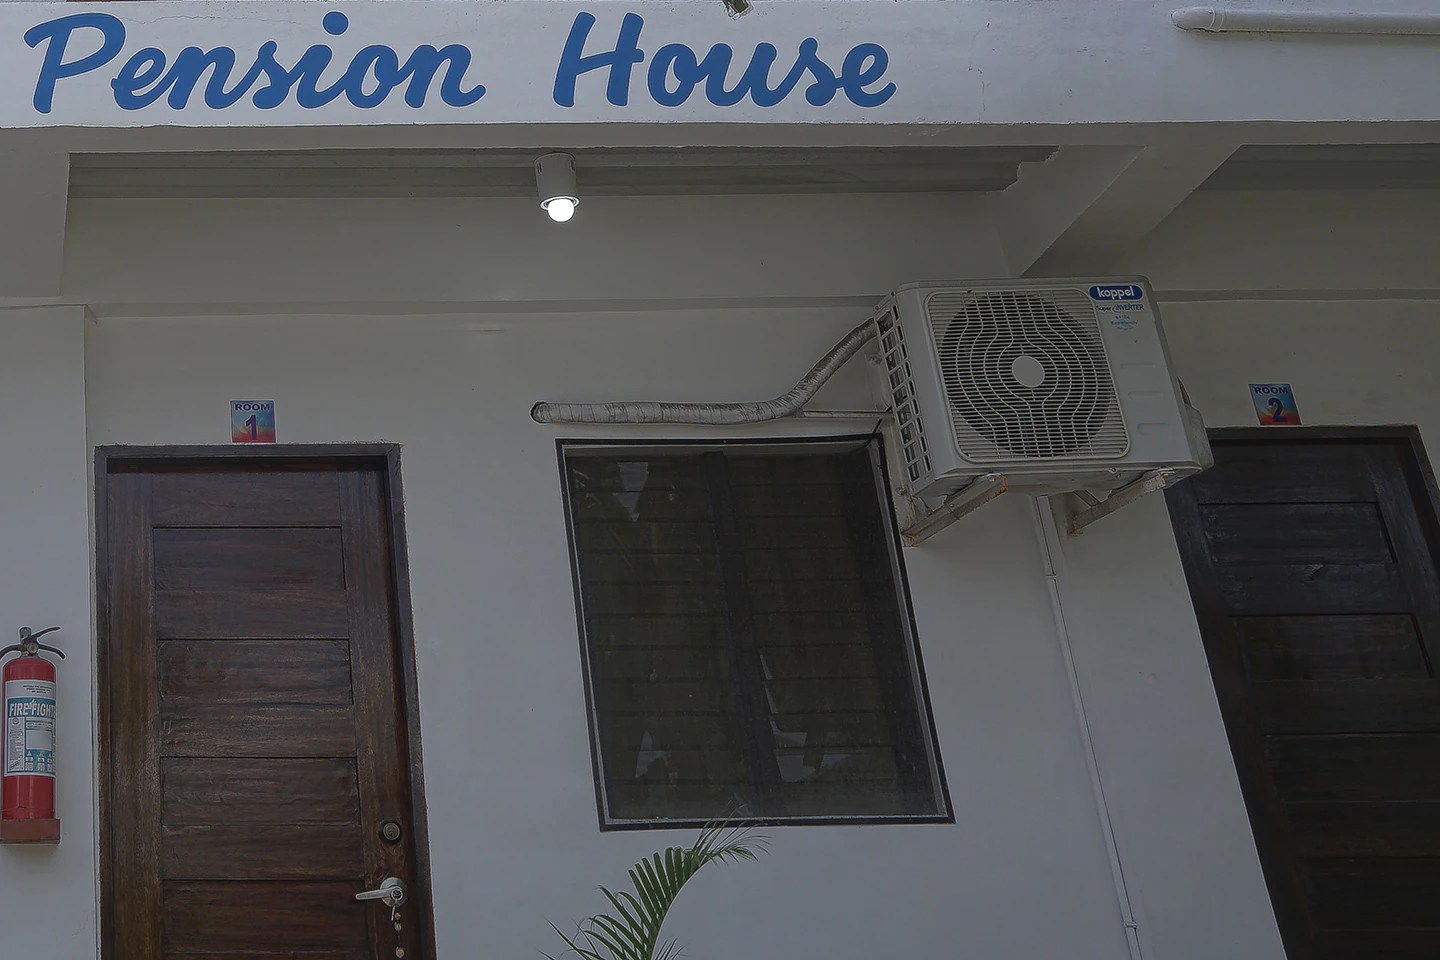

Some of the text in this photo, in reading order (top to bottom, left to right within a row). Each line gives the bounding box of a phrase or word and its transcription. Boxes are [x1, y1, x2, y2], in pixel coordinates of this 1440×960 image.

[24, 11, 486, 114] Pension
[553, 12, 896, 108] House
[1096, 285, 1135, 300] koppel
[1254, 386, 1289, 394] ROOM
[235, 403, 270, 411] ROOM
[1268, 397, 1289, 422] 2
[245, 414, 258, 441] 1
[9, 702, 29, 717] FIRE
